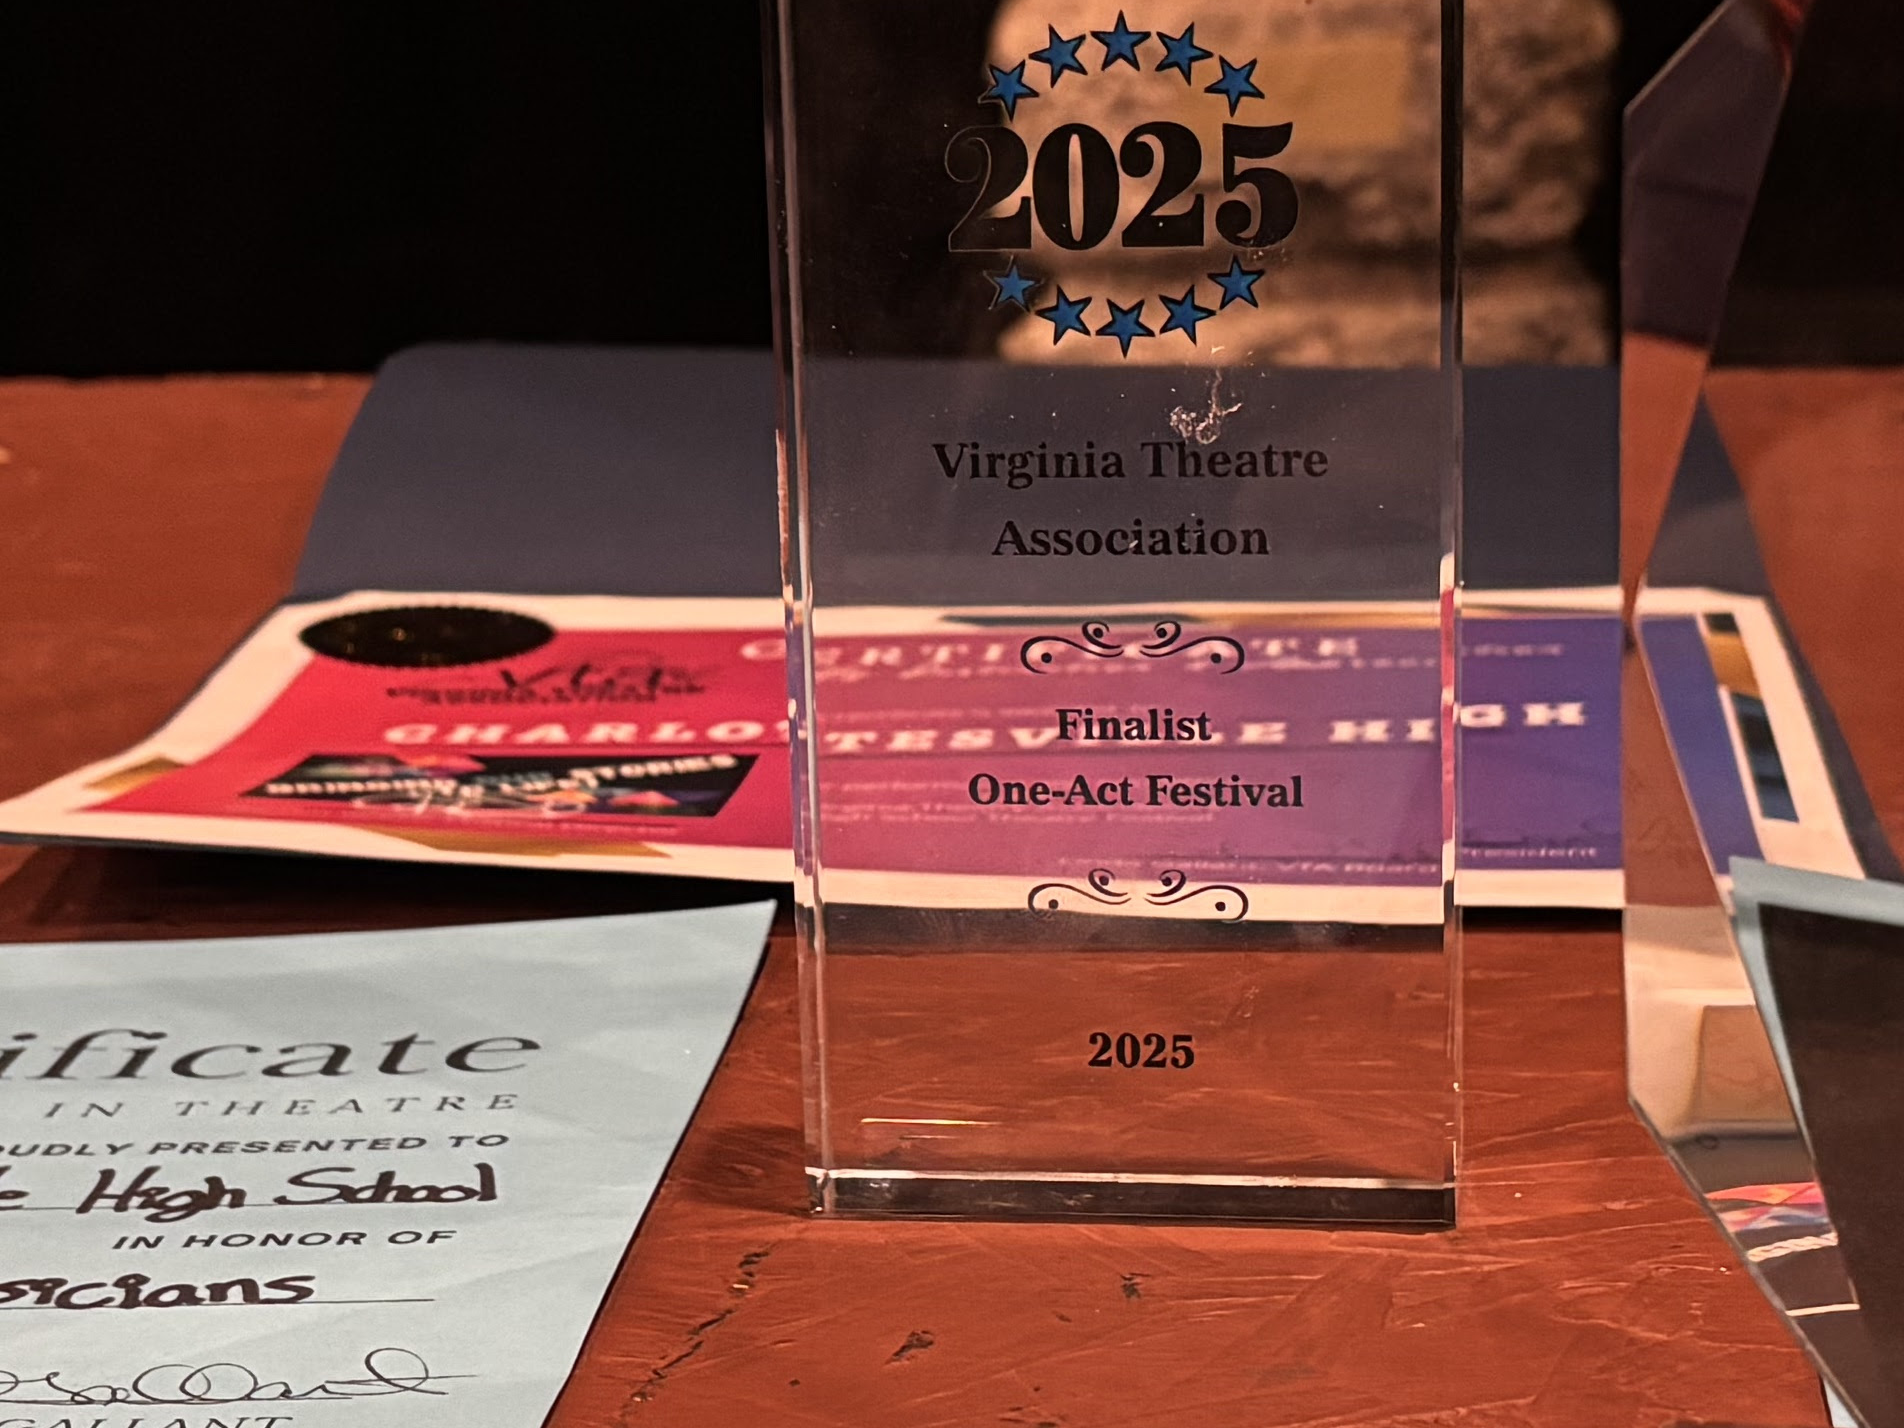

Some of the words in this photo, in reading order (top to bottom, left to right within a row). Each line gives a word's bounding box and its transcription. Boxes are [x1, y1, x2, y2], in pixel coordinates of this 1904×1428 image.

[944, 120, 1300, 253] 2025
[932, 441, 1126, 490] Virginia
[1140, 441, 1330, 479] Theatre
[991, 519, 1270, 558] Association
[1055, 708, 1213, 742] Finalist
[968, 772, 1135, 807] One-Act
[1144, 774, 1305, 808] Festival
[42, 1098, 130, 1120] IN
[170, 1092, 526, 1118] THEATRE
[147, 1134, 431, 1158] PRESENTED
[446, 1133, 510, 1151] TO
[75, 1161, 250, 1224] High
[272, 1160, 501, 1210] School
[110, 1230, 166, 1251] IN
[177, 1229, 372, 1250] HONOR
[384, 1228, 459, 1249] OF
